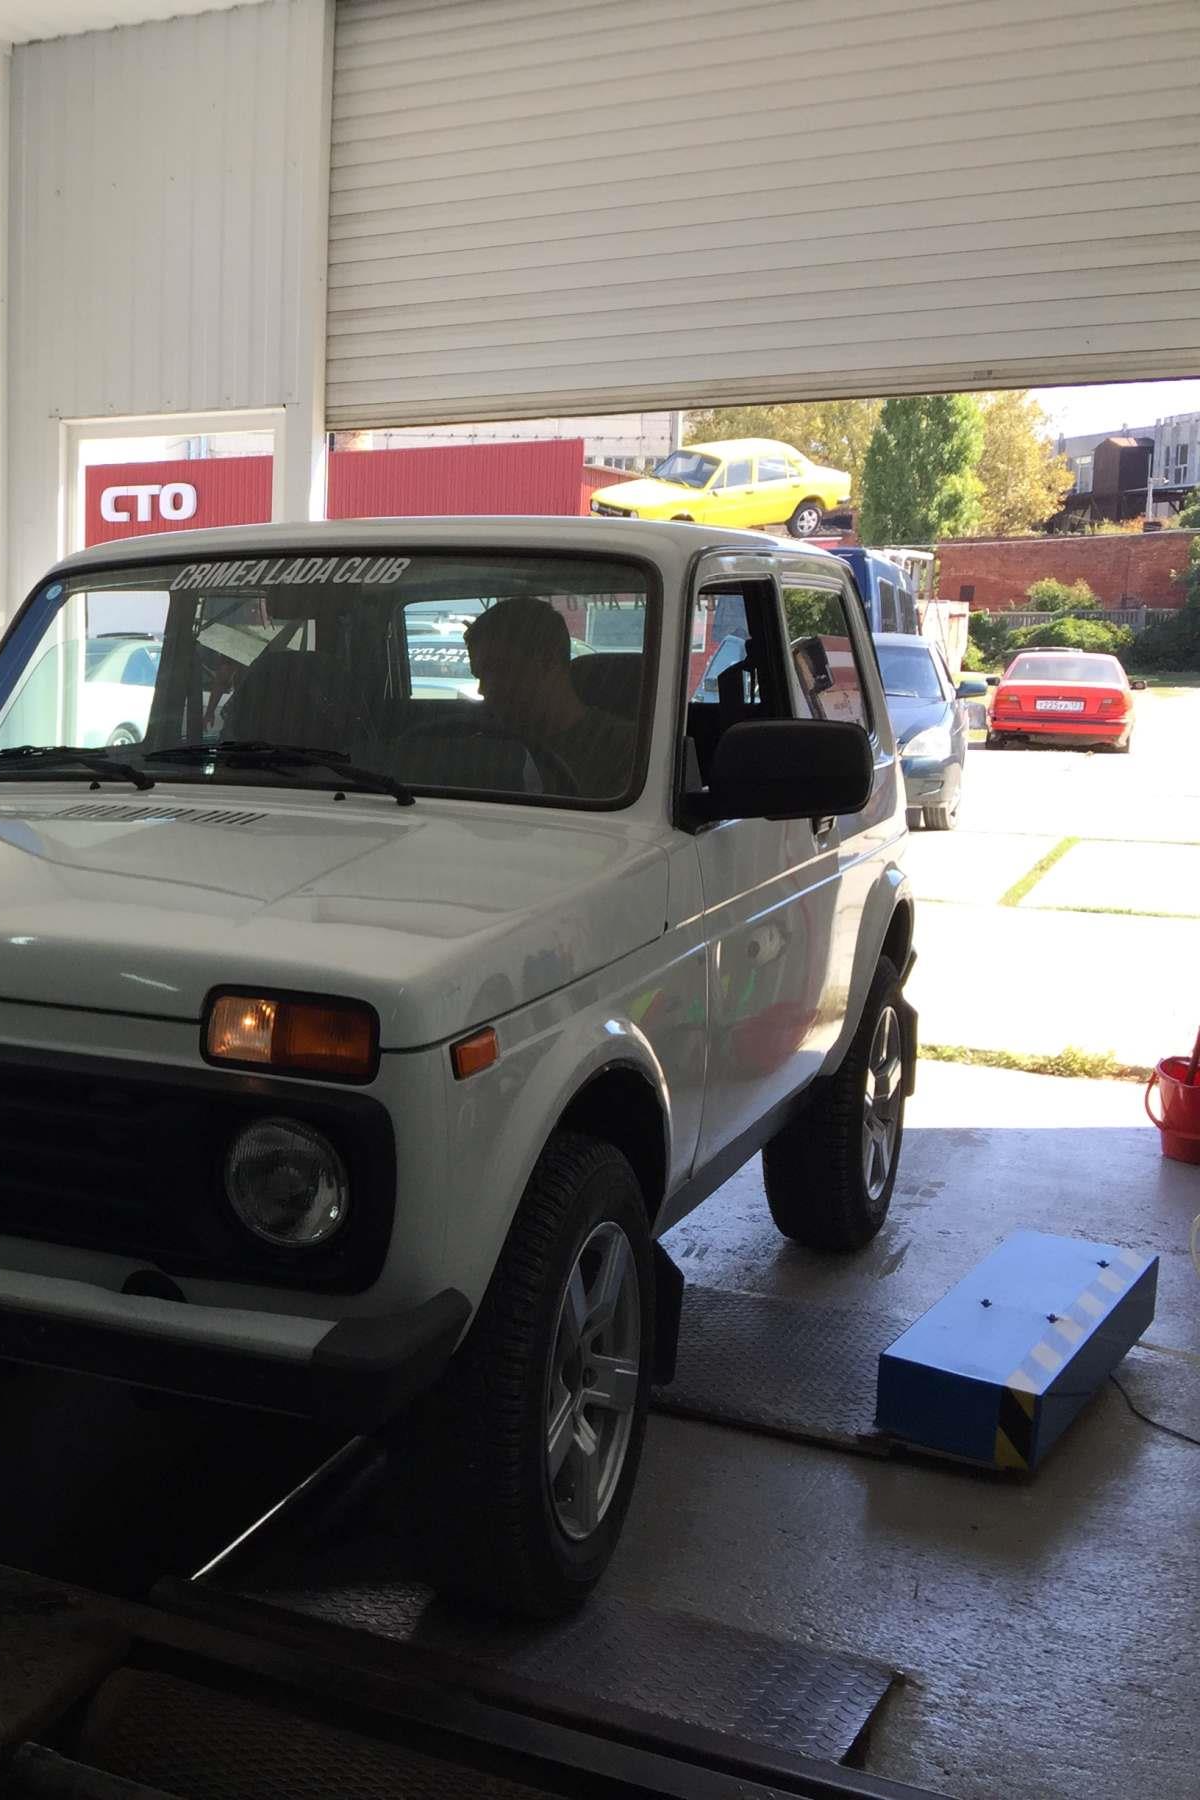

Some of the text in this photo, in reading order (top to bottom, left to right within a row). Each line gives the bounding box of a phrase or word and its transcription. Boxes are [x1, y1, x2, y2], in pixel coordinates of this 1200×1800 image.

[100, 482, 197, 522] СТО
[169, 557, 411, 590] CRIMEA LADA CLUB
